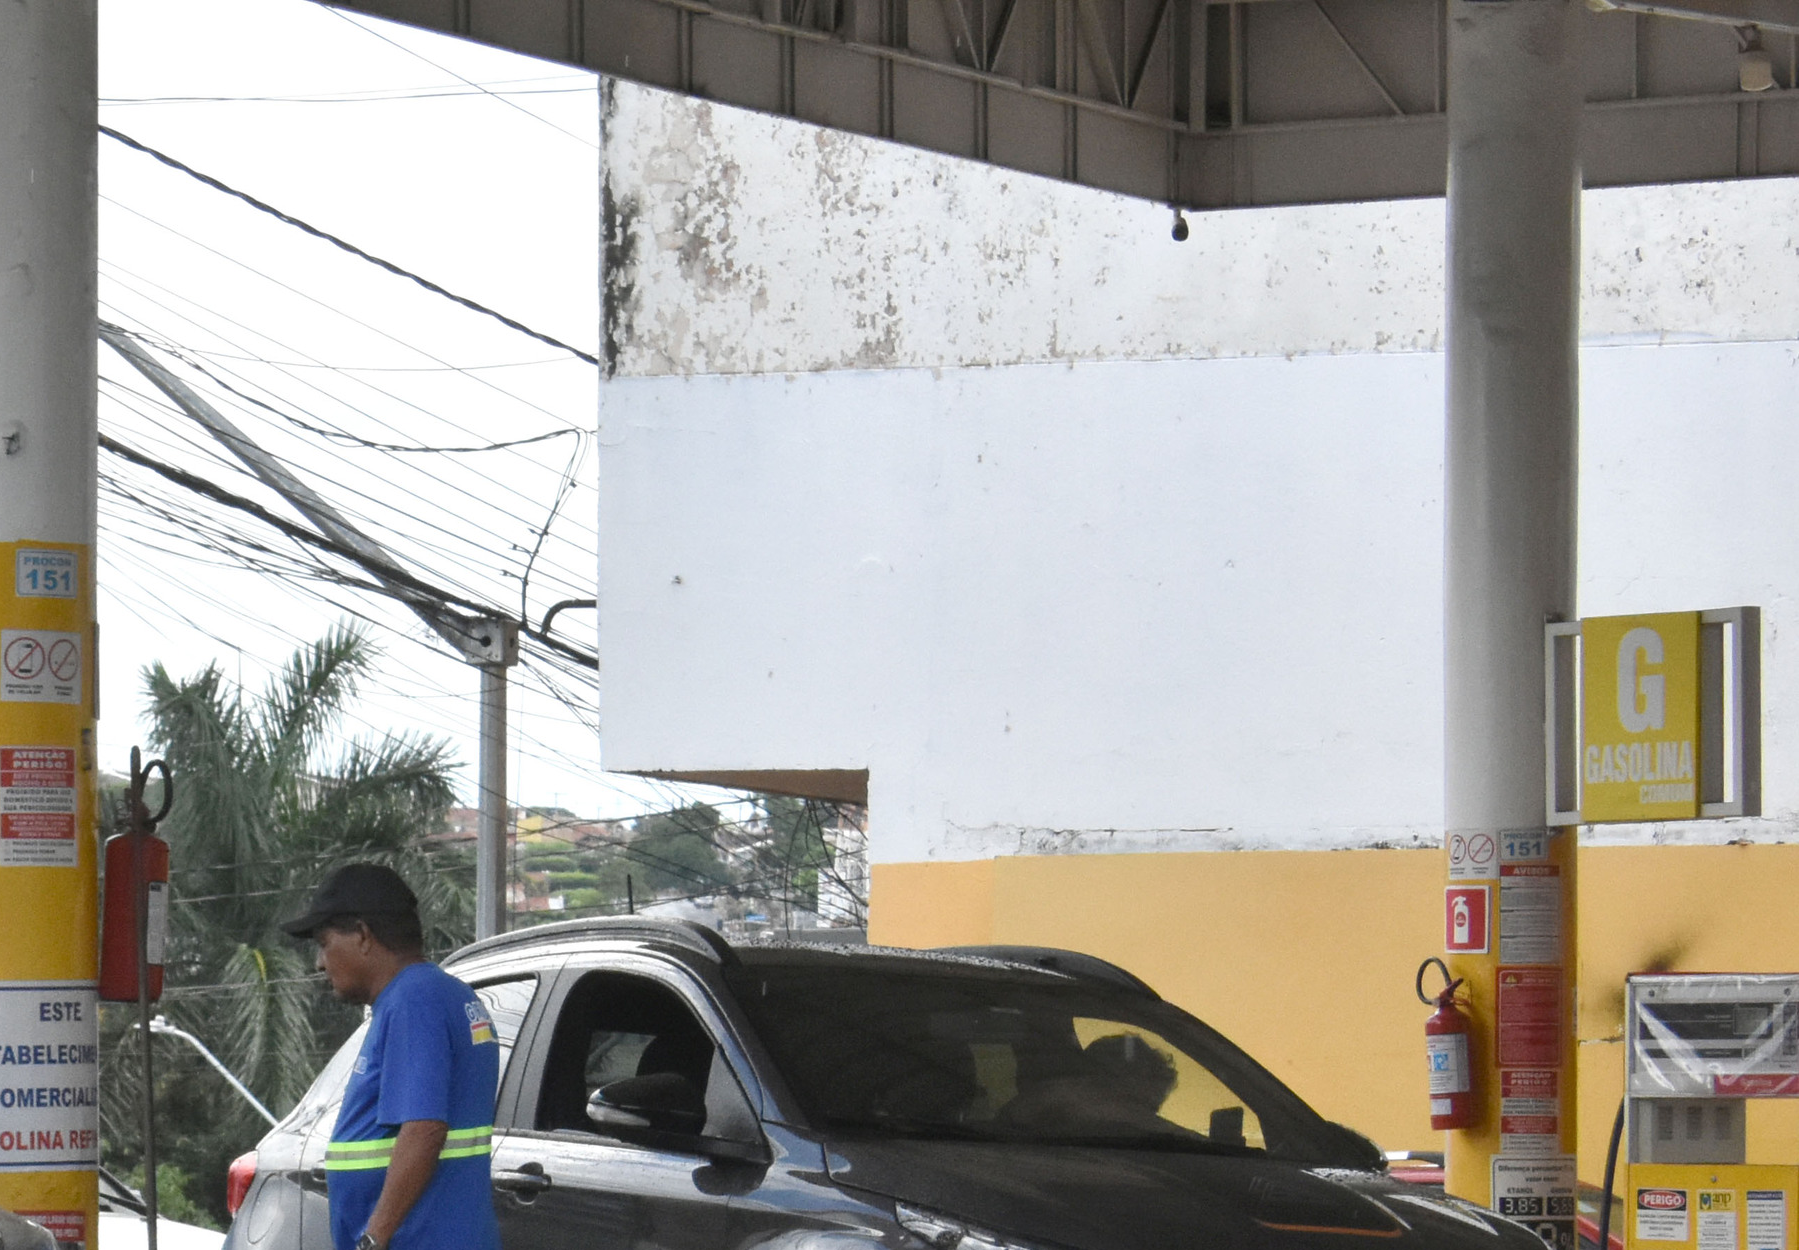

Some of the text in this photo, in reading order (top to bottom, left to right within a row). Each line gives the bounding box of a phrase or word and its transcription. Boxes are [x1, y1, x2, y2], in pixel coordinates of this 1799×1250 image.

[24, 556, 71, 567] PROCON
[26, 569, 71, 592] 151
[1617, 627, 1665, 733] G
[1585, 740, 1693, 784] GASOLINA
[1506, 841, 1541, 856] 151
[39, 1002, 83, 1022] ESTE
[1644, 1194, 1682, 1206] PERIGO
